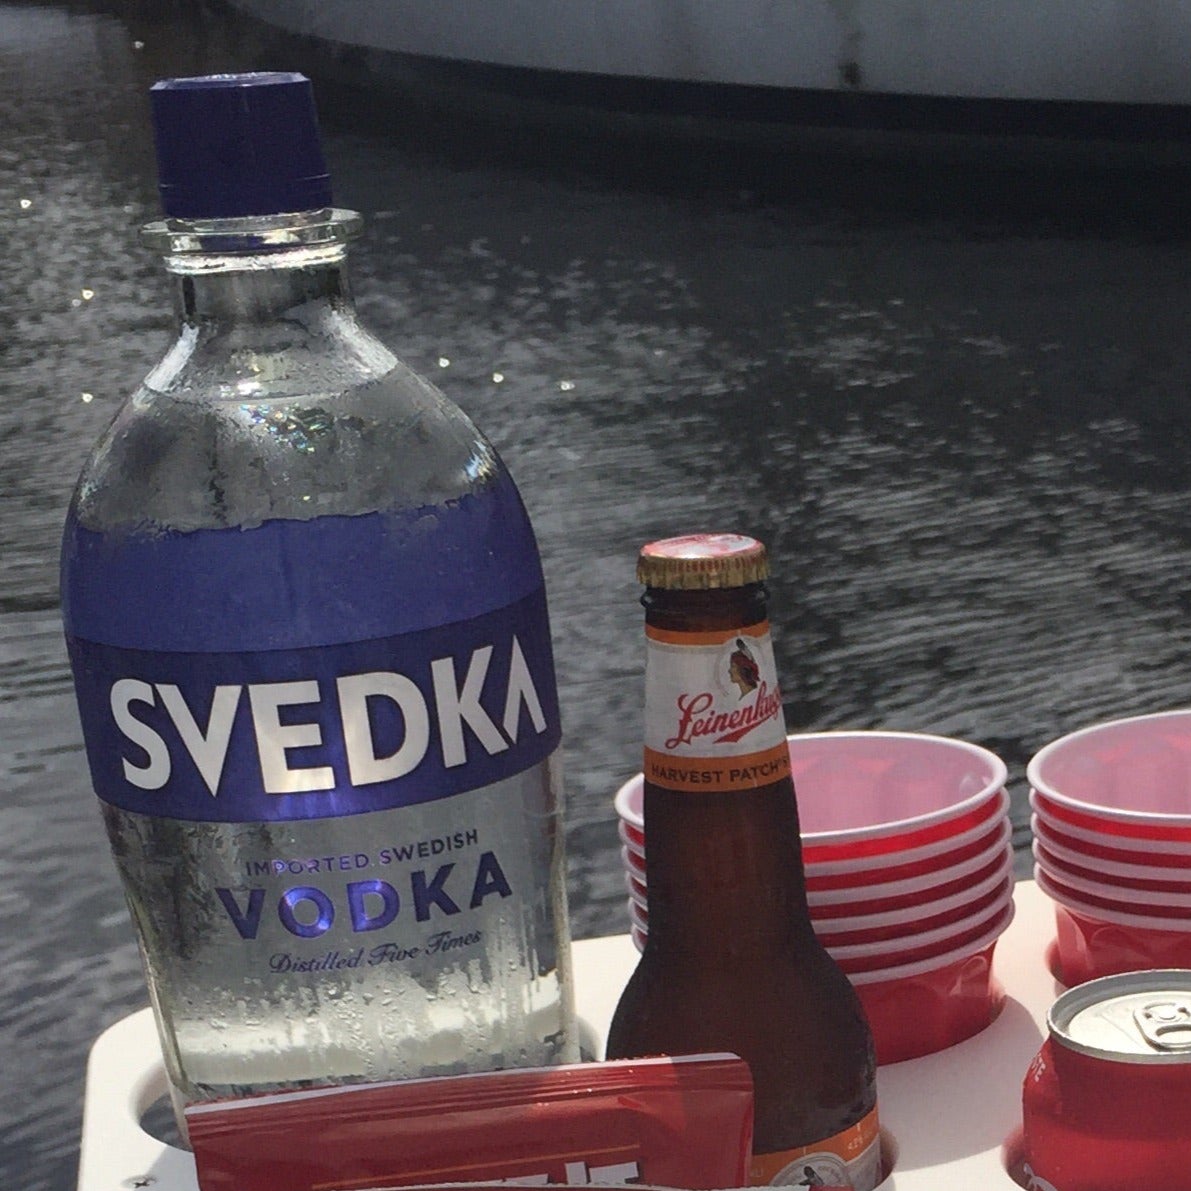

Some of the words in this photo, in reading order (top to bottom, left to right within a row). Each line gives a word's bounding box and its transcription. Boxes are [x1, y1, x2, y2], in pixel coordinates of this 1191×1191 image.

[110, 634, 547, 797] SVEDKA
[651, 764, 723, 783] HARVEST
[729, 762, 779, 781] PATCH
[246, 854, 370, 877] IMPORTED
[379, 829, 479, 865] SWEDISH
[215, 851, 513, 940] VODKA
[269, 950, 363, 974] Distilled
[367, 943, 421, 965] Five
[425, 929, 482, 956] Times
